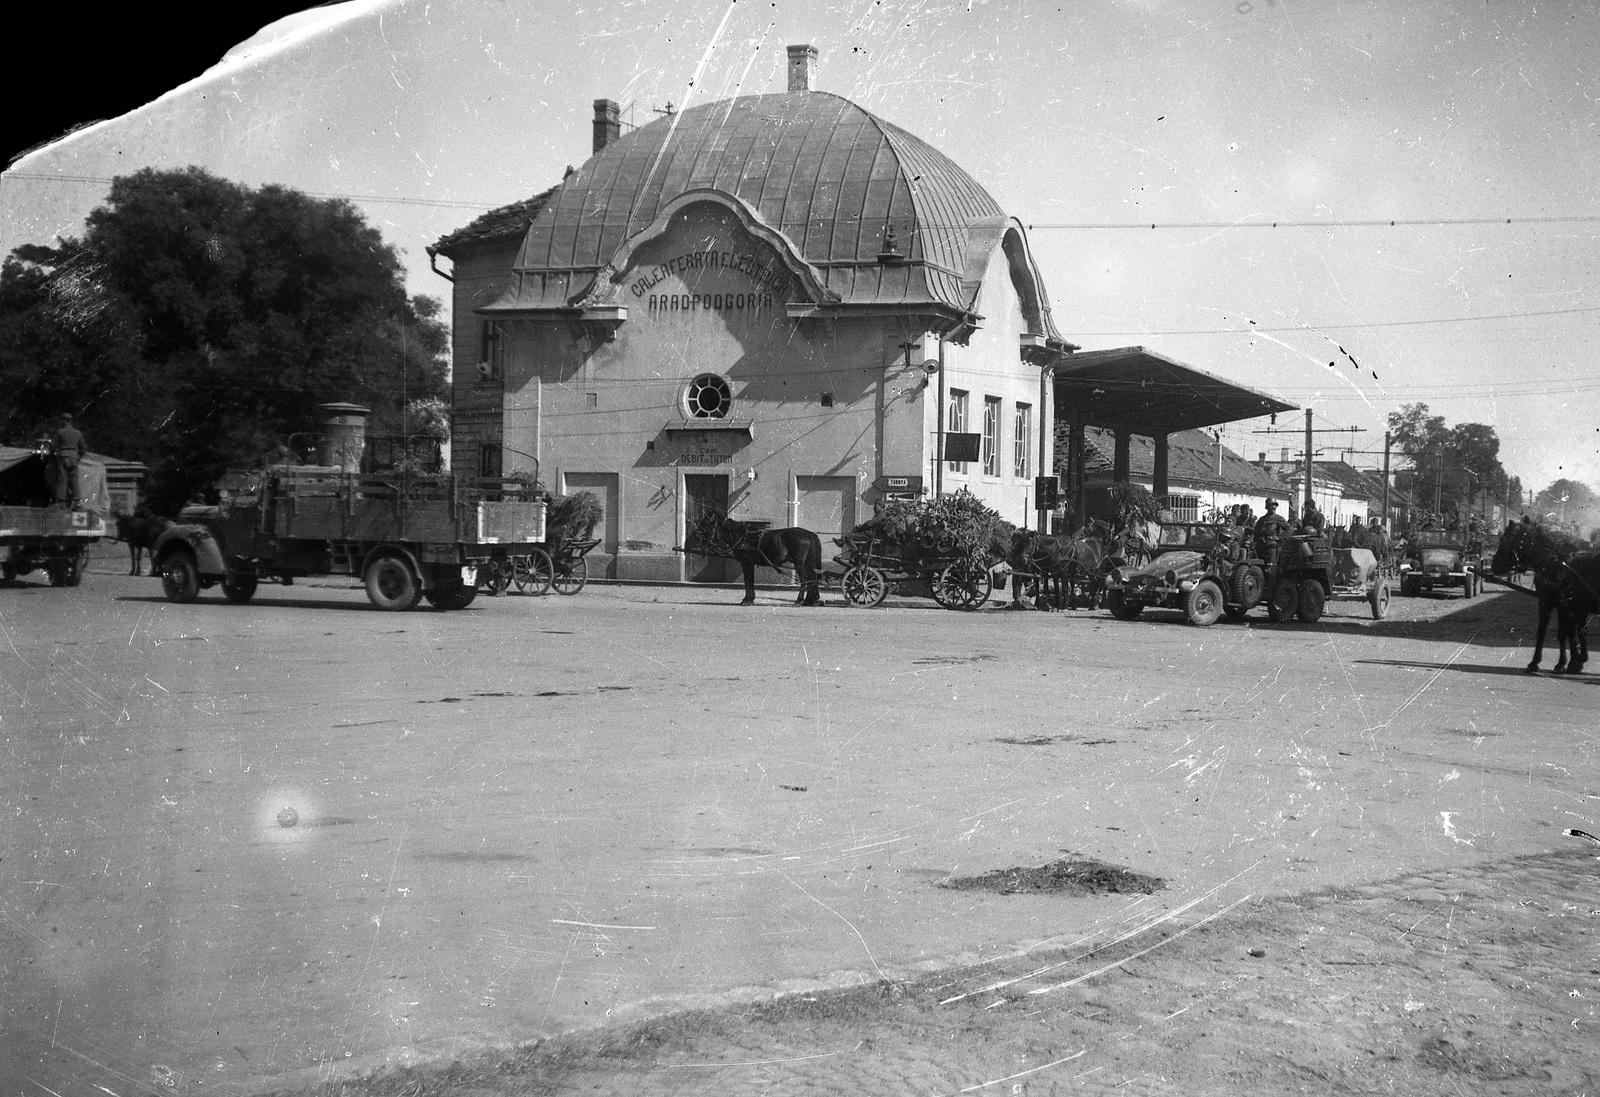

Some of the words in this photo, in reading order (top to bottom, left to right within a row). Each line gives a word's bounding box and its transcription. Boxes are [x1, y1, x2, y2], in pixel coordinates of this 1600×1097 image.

[631, 263, 671, 297] CALEA
[669, 250, 718, 275] FERATA
[681, 454, 704, 463] DEBIT
